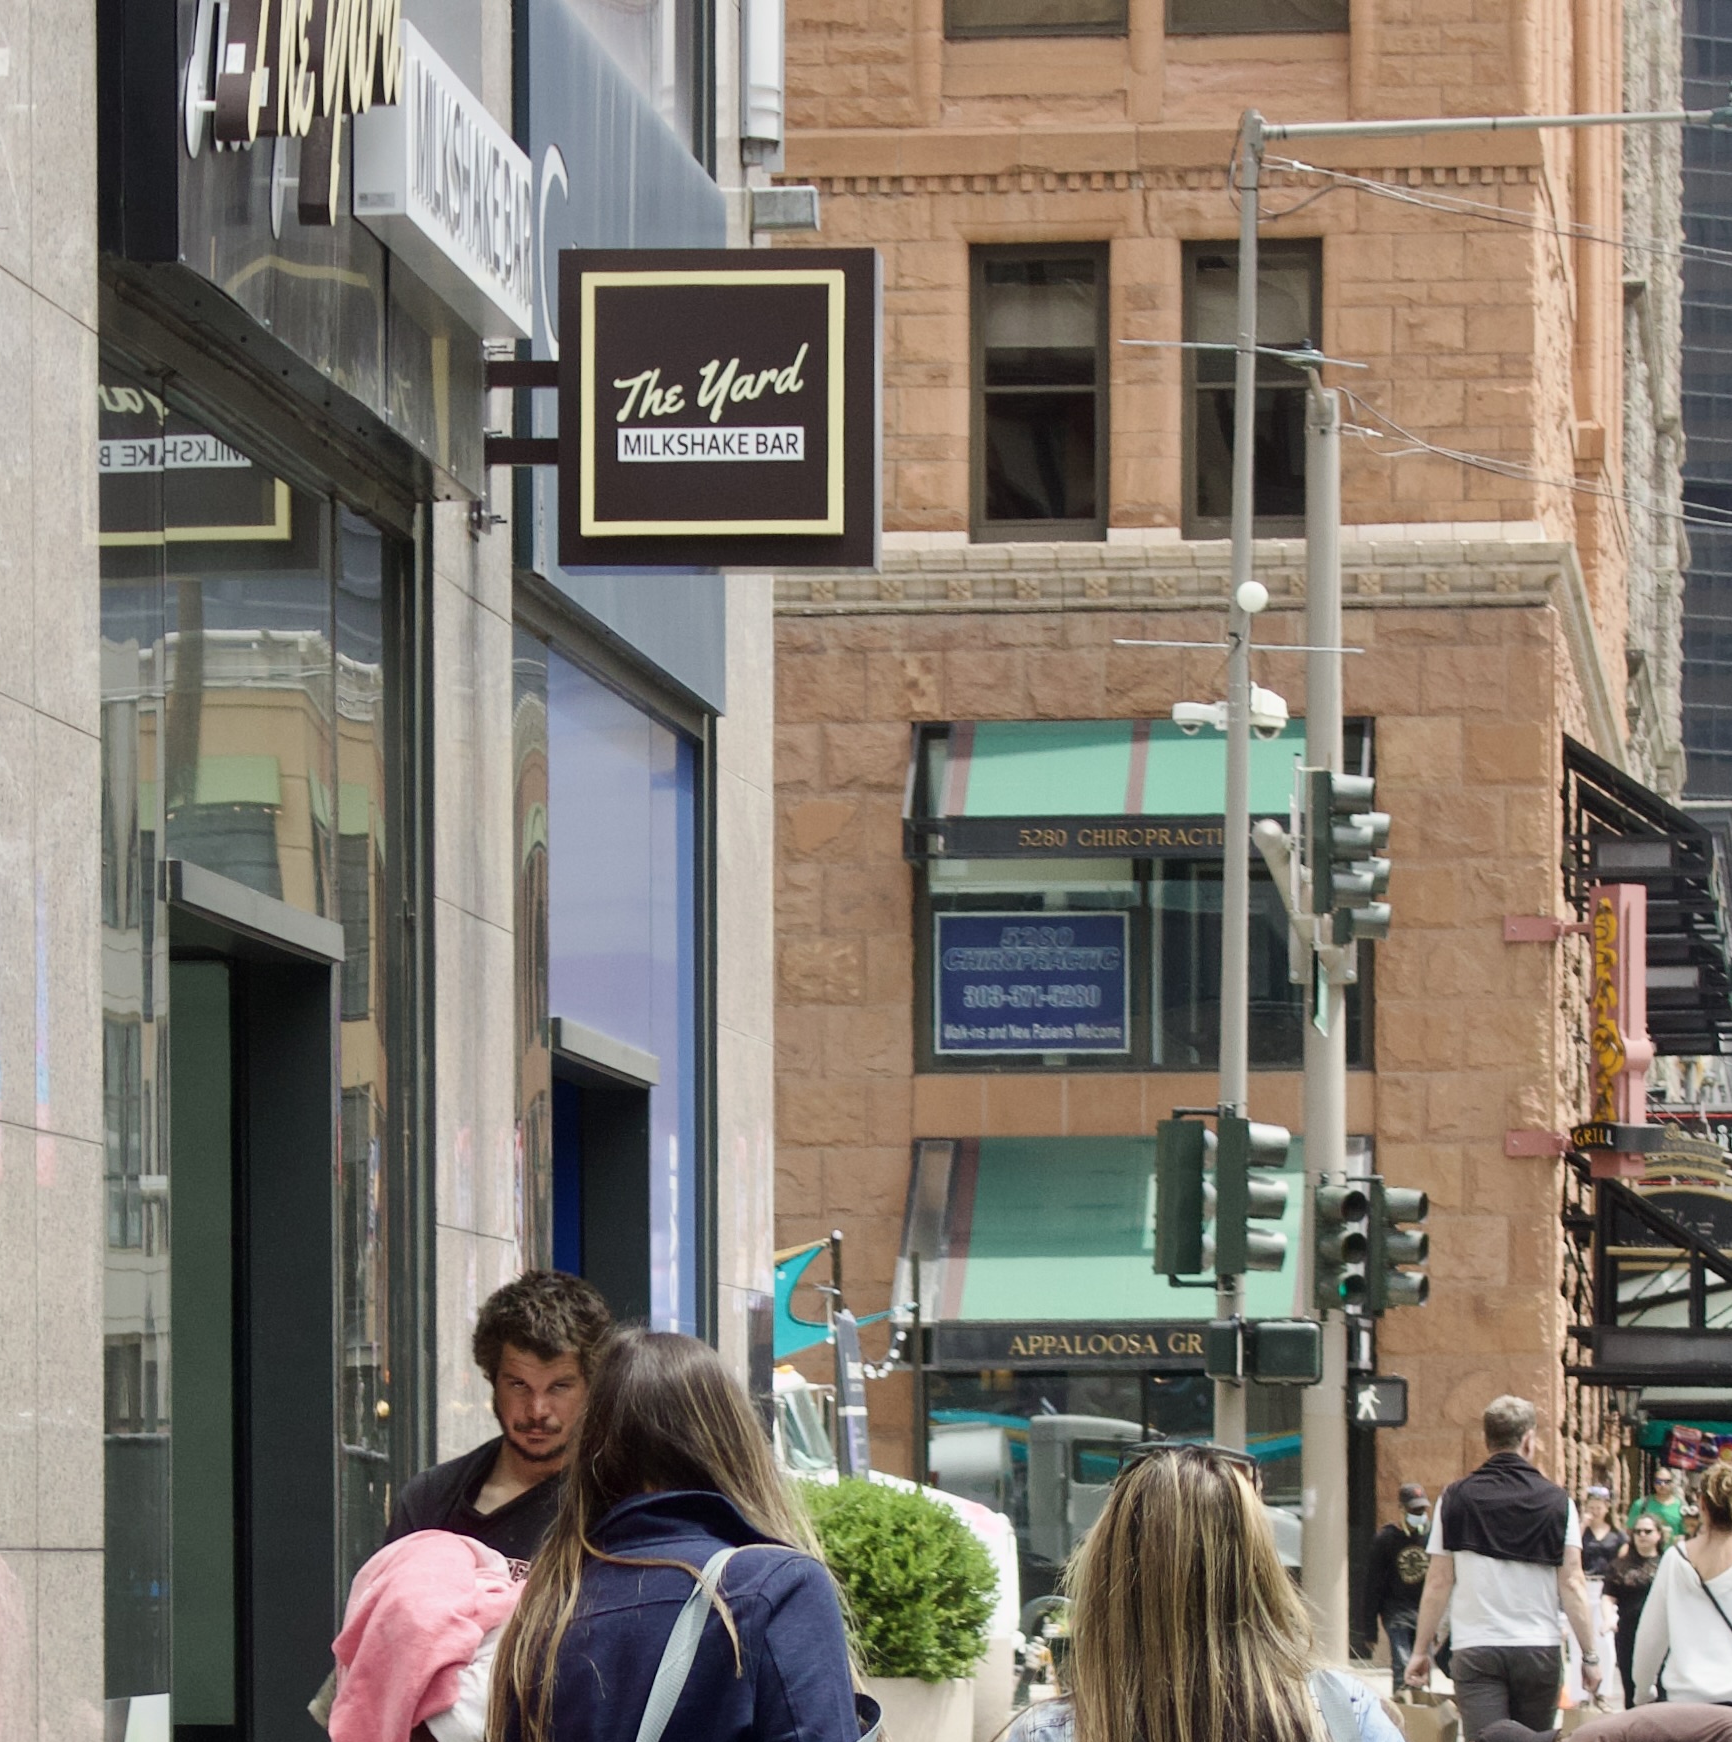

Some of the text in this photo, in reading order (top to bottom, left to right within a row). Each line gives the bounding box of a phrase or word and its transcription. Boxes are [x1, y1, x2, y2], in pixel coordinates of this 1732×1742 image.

[411, 56, 533, 310] MILKSHAKE BAR
[615, 343, 809, 424] The Yard
[623, 430, 801, 457] MILKSHAKE BAR
[1018, 827, 1224, 848] 5280 CHIROPRACTI
[1001, 926, 1075, 949] 5280
[942, 946, 1121, 972] CHIROPRACTIC
[988, 1024, 1007, 1040] and
[1009, 1023, 1031, 1040] New
[1033, 1023, 1074, 1041] Patients
[1076, 1022, 1122, 1041] Welcome
[1571, 1124, 1615, 1153] GRILL
[1008, 1333, 1160, 1357] APPALOOSA
